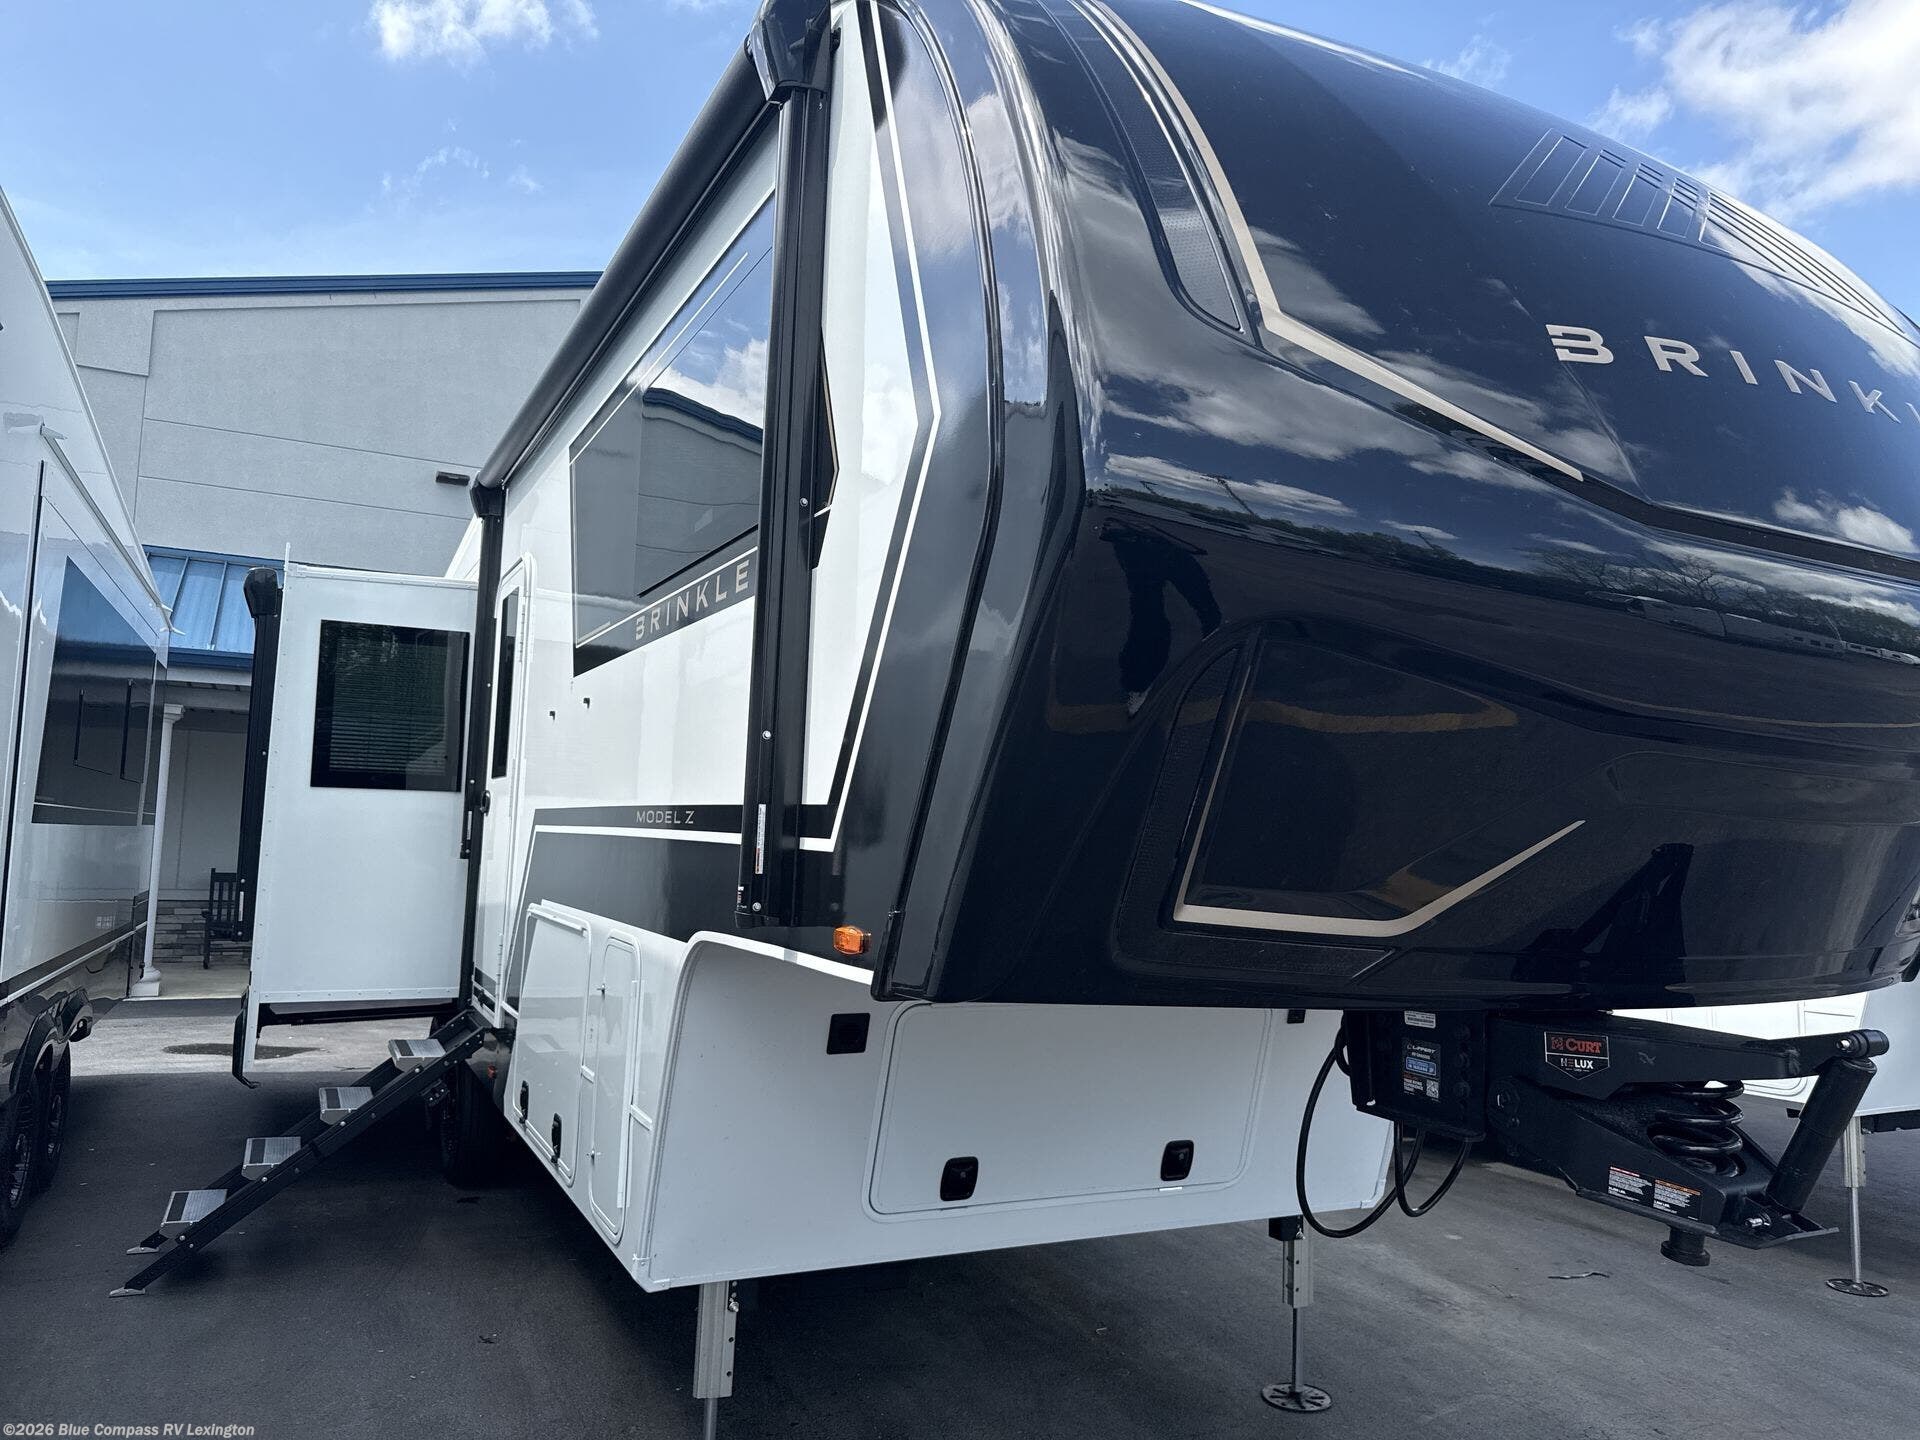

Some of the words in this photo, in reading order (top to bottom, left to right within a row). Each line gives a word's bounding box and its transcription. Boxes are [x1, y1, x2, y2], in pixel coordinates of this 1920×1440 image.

[636, 810, 681, 824] MODEL
[685, 810, 695, 824] Z
[1565, 1037, 1602, 1054] CURT
